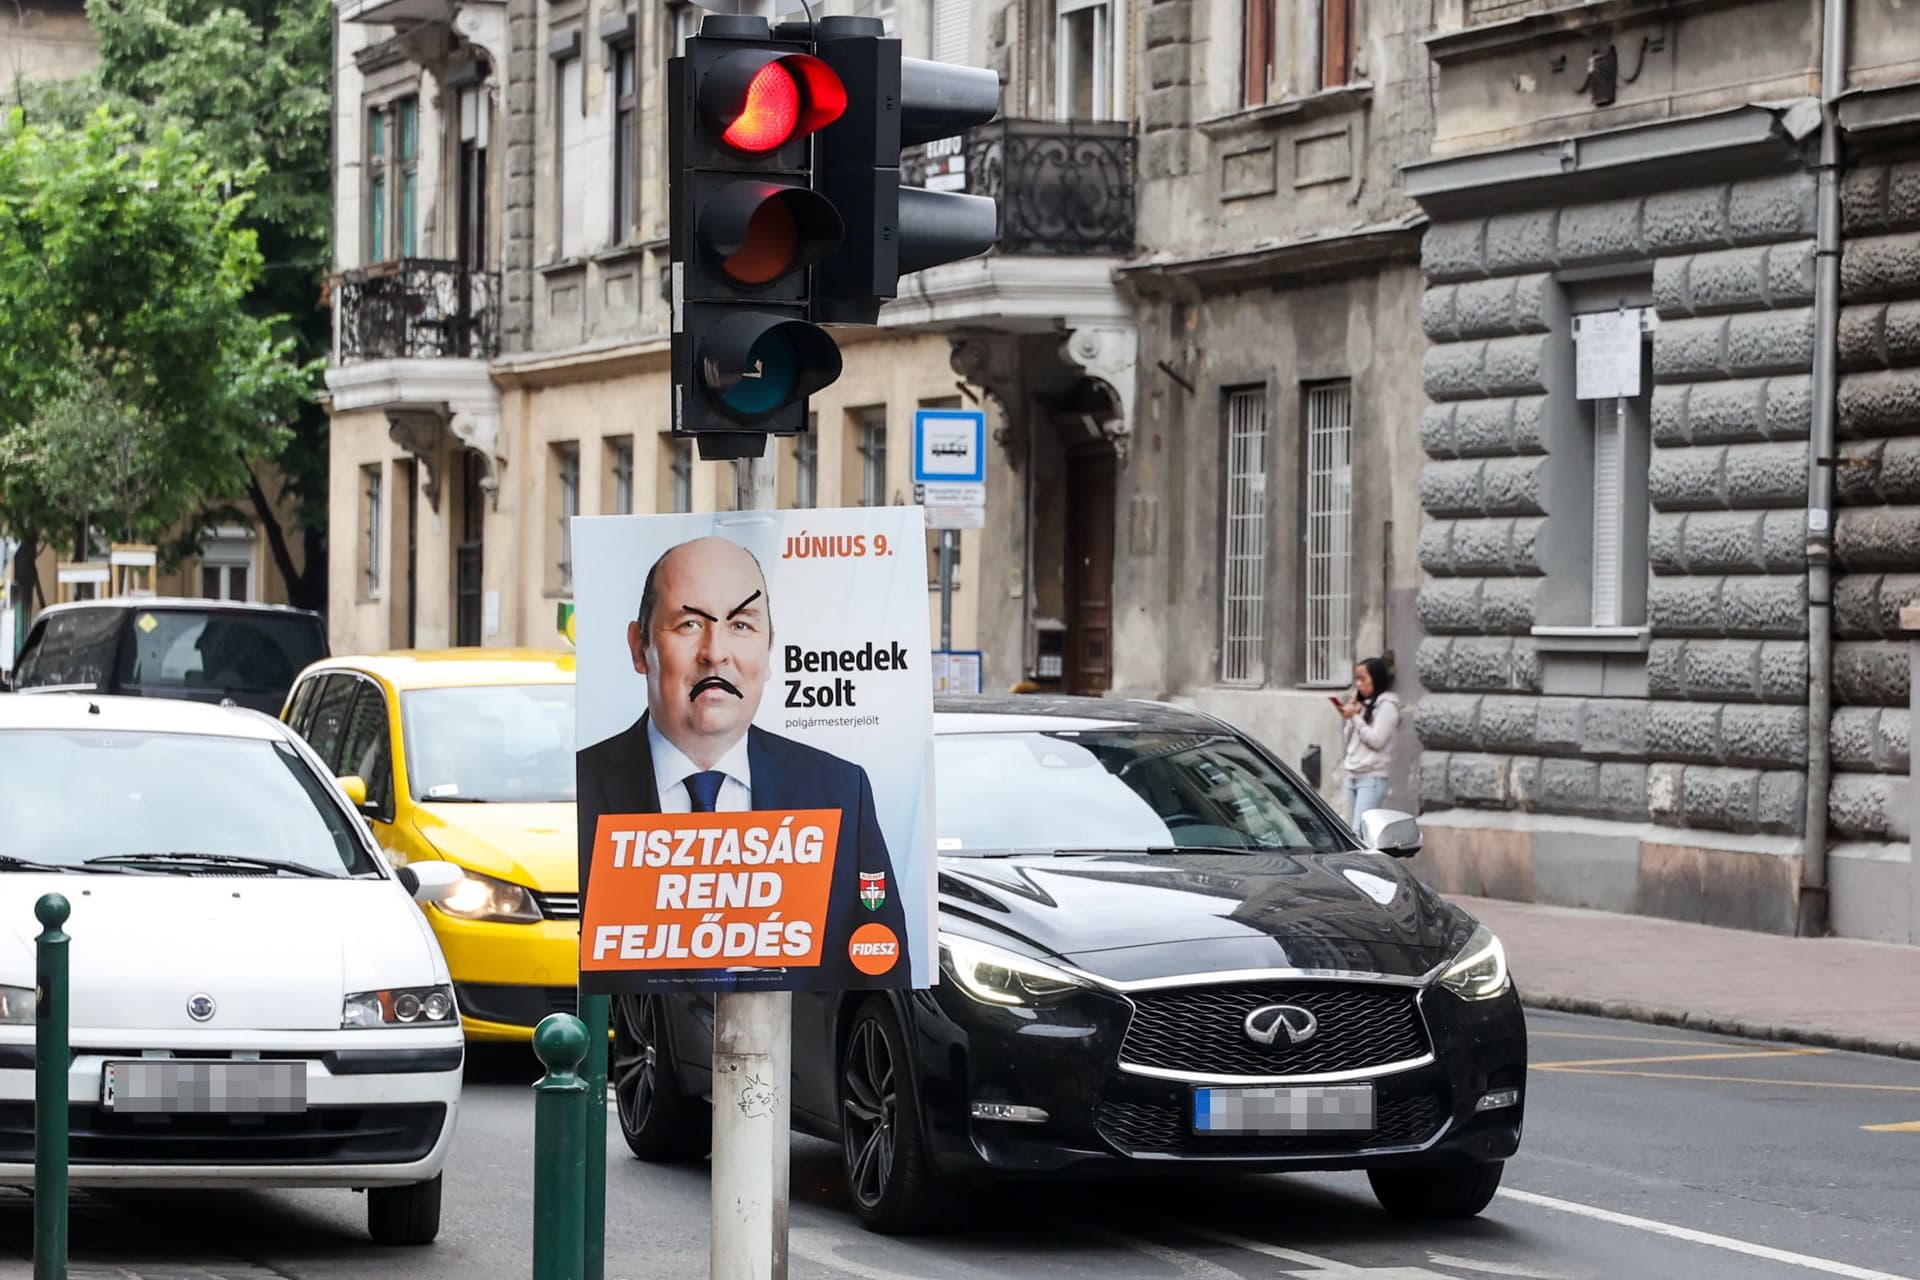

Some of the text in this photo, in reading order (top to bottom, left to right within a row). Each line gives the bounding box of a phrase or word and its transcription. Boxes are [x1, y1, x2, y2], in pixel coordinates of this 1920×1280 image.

[782, 531, 893, 559] JÚNIUS 9.
[784, 641, 908, 673] Benedek
[784, 678, 856, 708] Zsolt
[785, 715, 880, 729] polgármesterjelölt
[610, 816, 825, 868] TISZTASÁG
[655, 872, 783, 909] REND
[592, 911, 813, 960] FEJLŐDÉS
[851, 942, 897, 956] FIDESZ
